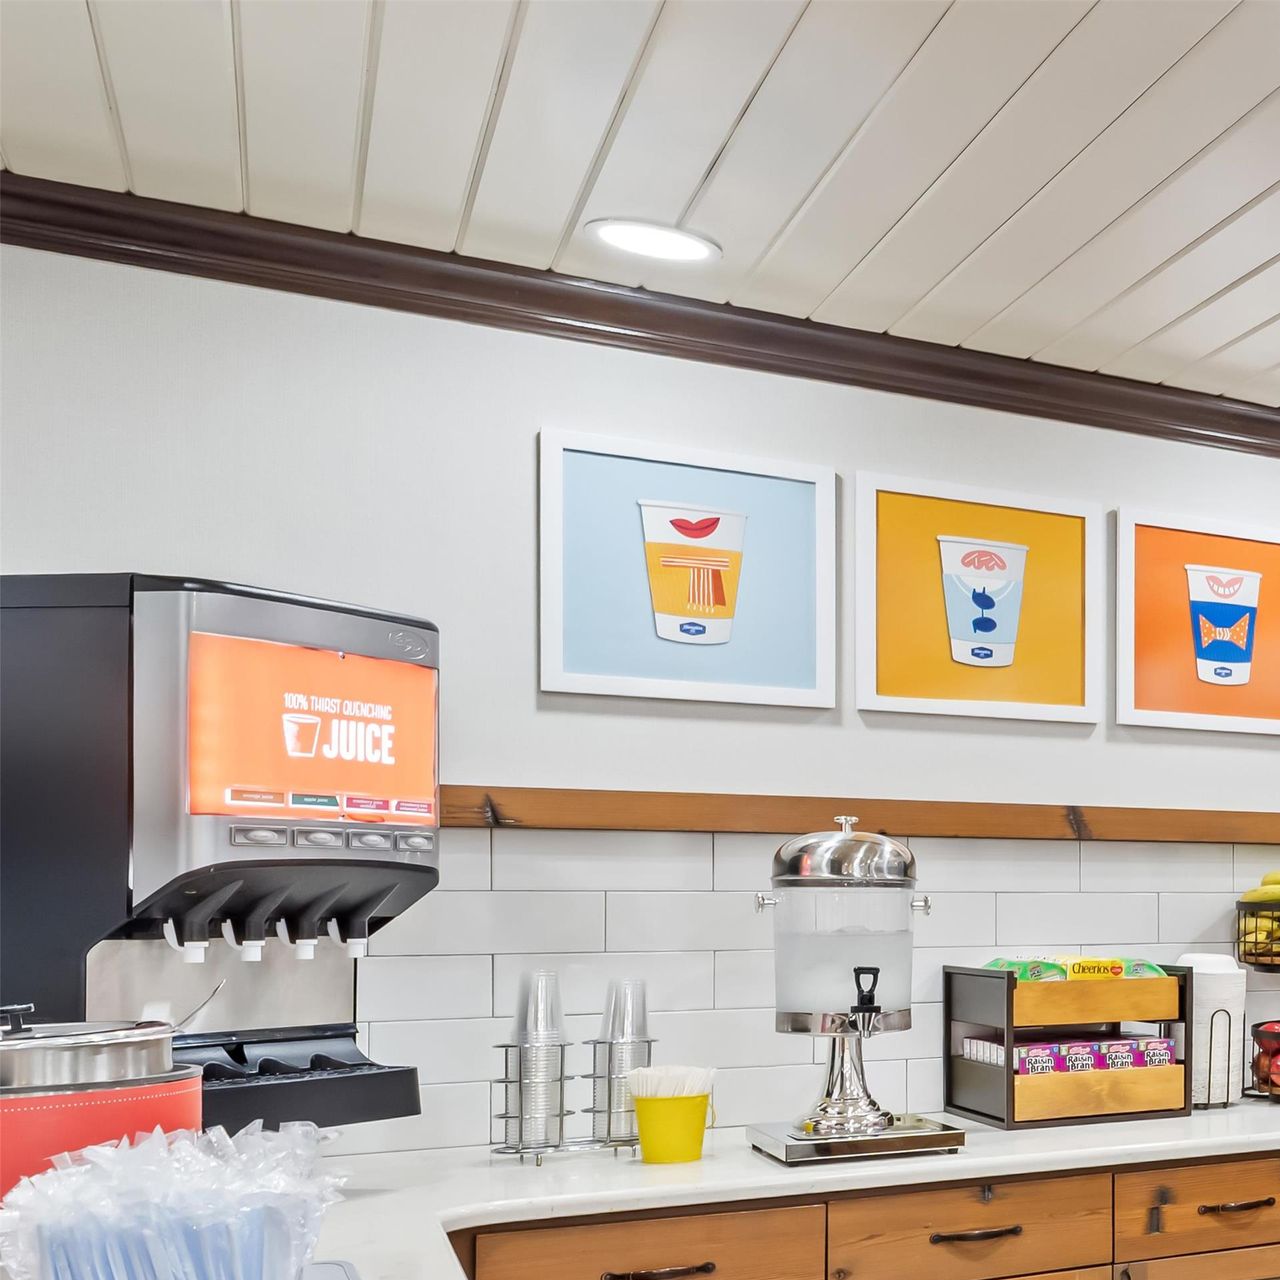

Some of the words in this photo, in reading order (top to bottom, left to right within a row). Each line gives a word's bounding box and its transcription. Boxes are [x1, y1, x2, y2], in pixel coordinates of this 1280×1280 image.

[284, 692, 309, 711] 100%
[310, 695, 342, 715] THIRST
[342, 699, 393, 721] QUENCHING
[322, 718, 396, 766] JUICE
[1072, 962, 1110, 975] Cheerios
[1067, 1055, 1093, 1064] Raisin
[1108, 1053, 1132, 1061] Raisin
[1145, 1051, 1170, 1059] Raisin
[1027, 1057, 1053, 1066] Raisin
[1110, 1060, 1130, 1068] Bran
[1148, 1058, 1167, 1066] Bran
[1030, 1064, 1051, 1073] Bran
[1070, 1062, 1090, 1071] Bran
